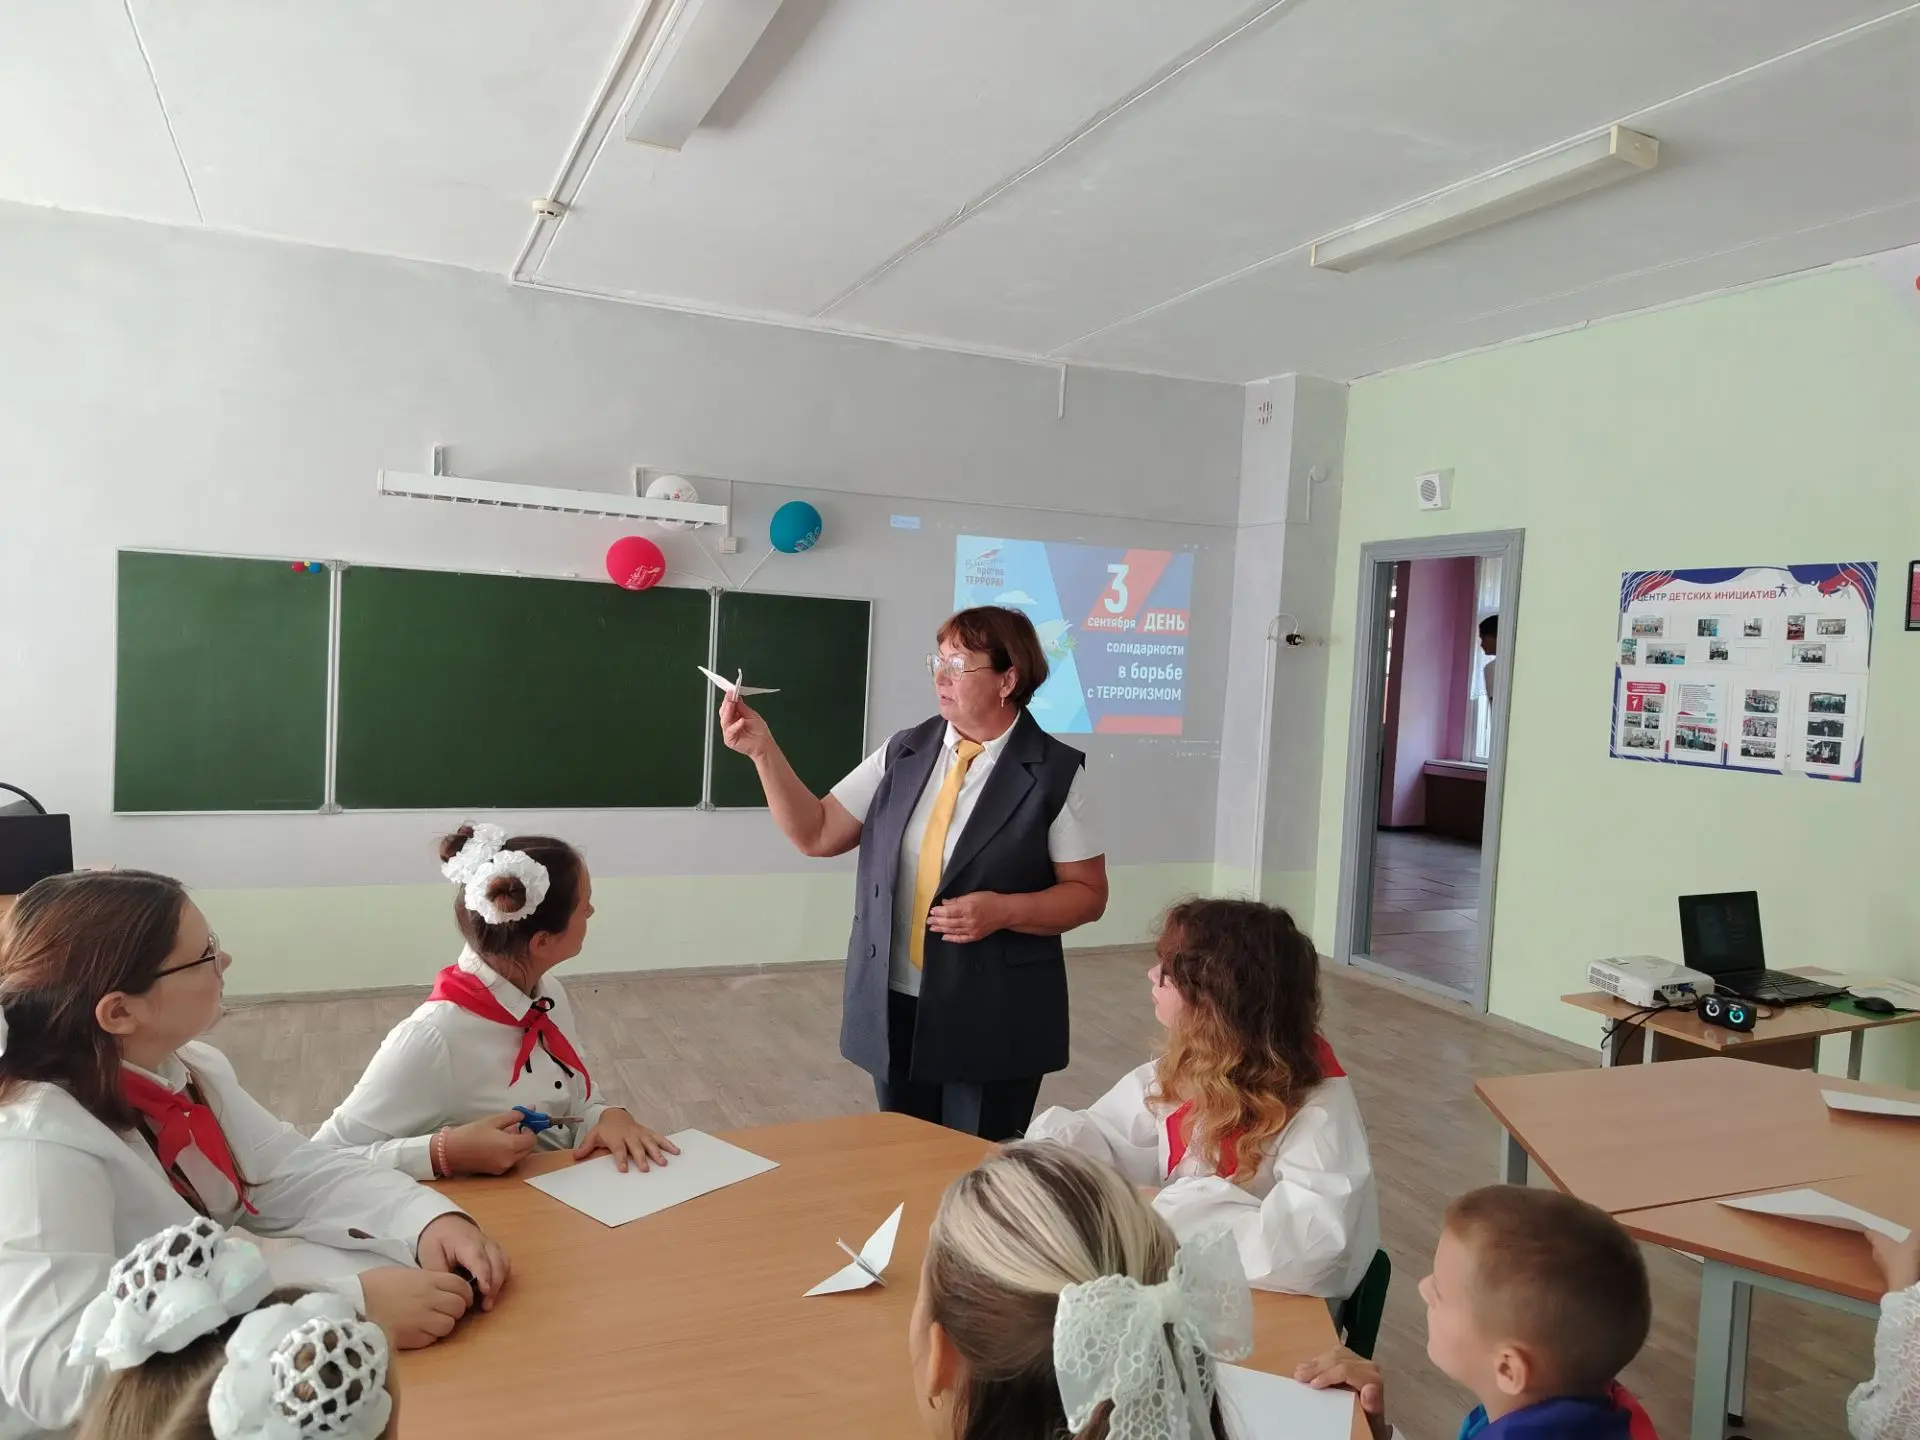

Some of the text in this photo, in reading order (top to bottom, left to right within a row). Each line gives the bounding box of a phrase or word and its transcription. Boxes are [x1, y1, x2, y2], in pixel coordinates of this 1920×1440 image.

[1104, 564, 1129, 613] 3
[1668, 592, 1712, 601] ДЕТСКИХ
[1714, 590, 1777, 600] ИНИЦИАТИВ
[1087, 613, 1186, 632] сентября ДЕНЬ
[1106, 642, 1184, 656] солидарности
[1118, 662, 1183, 683] в борьбе
[1087, 686, 1182, 701] с ТЕРРОРИЗМОМ
